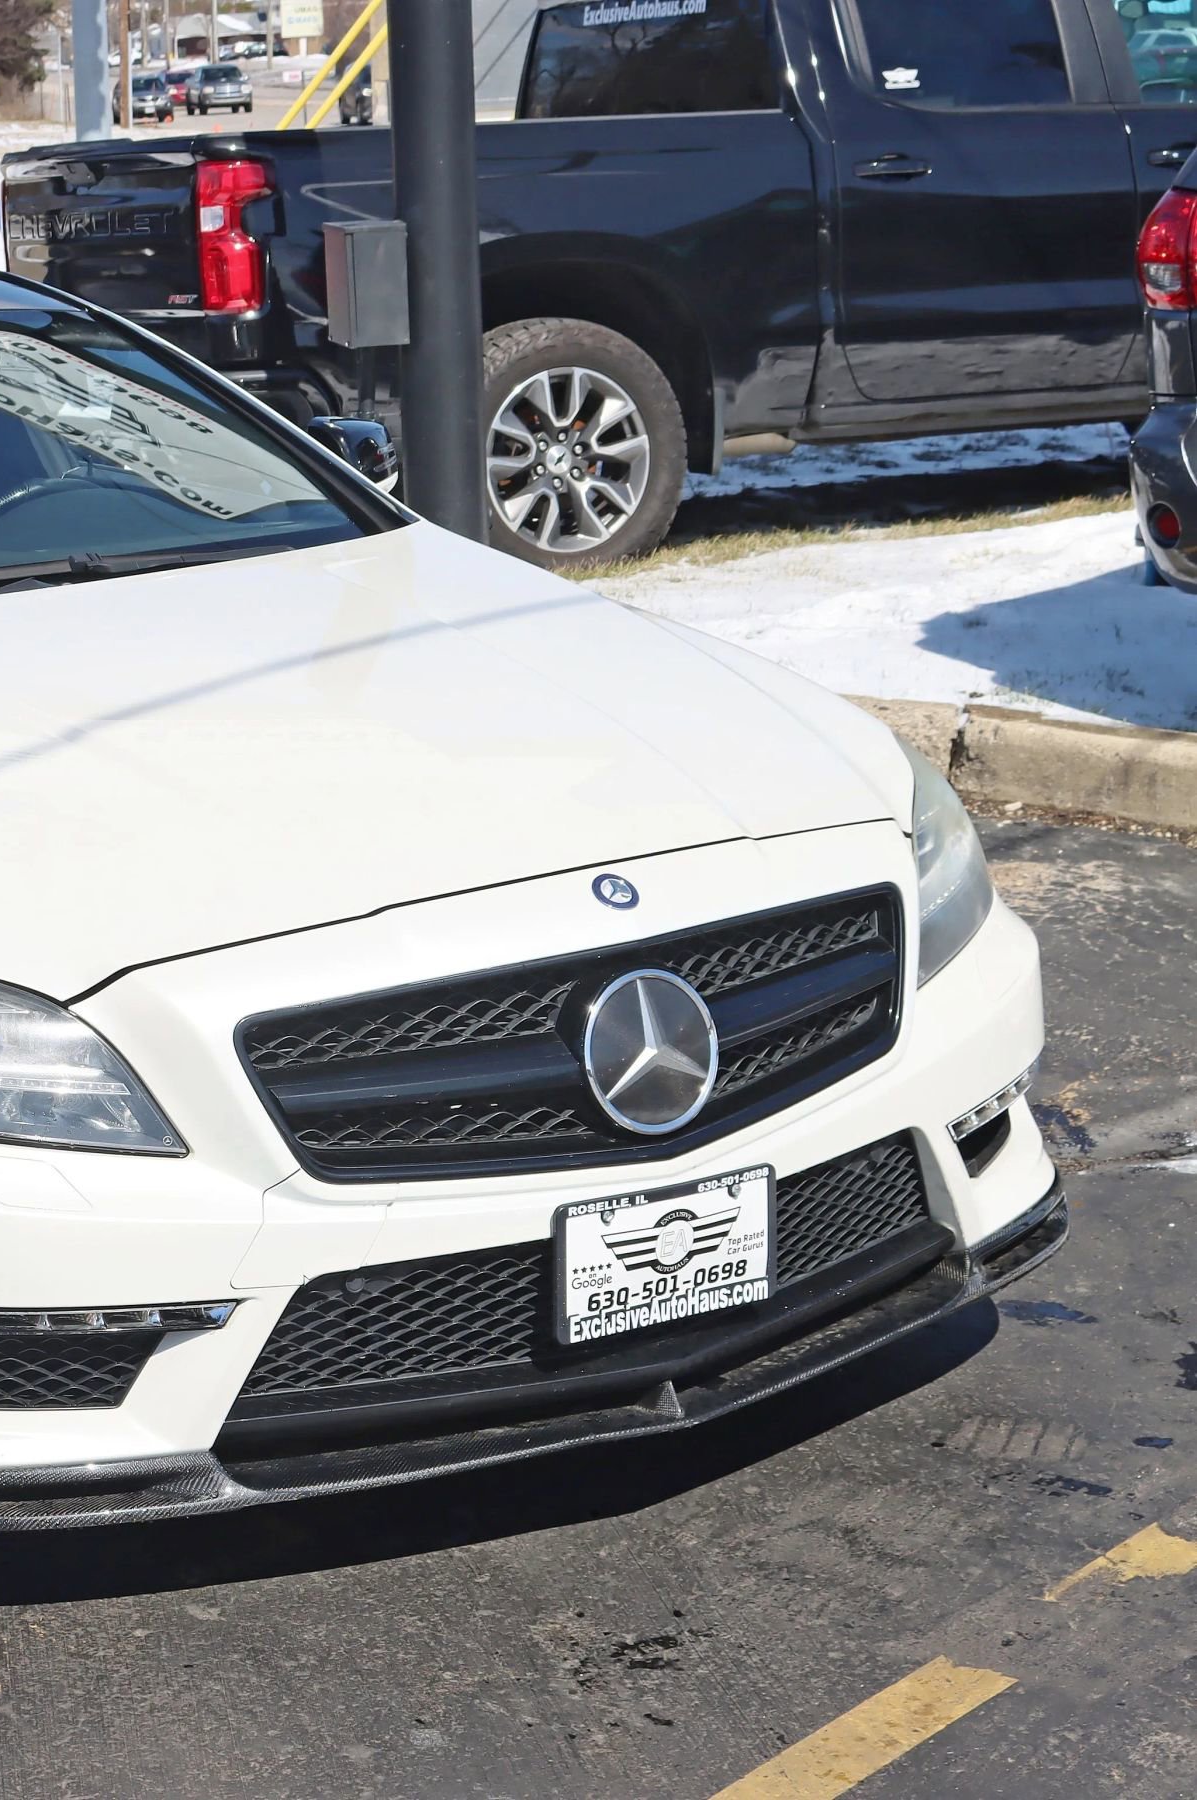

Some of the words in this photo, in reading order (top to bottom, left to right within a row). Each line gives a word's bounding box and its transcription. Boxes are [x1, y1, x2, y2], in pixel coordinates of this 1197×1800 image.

[583, 0, 707, 27] ExclusiveAutohaus.com
[9, 210, 175, 241] CHEVROLET
[697, 1167, 770, 1193] 630-501-0698
[568, 1197, 632, 1217] ROSELLE,
[635, 1195, 649, 1205] IL
[660, 1211, 693, 1226] EXCLUSIVE
[727, 1236, 742, 1247] Top
[743, 1229, 765, 1243] Rated
[727, 1246, 741, 1256] Car
[742, 1241, 765, 1253] Gurus
[655, 1256, 689, 1273] AUTOHAUS
[571, 1273, 613, 1290] Google
[587, 1259, 748, 1313] 630-501-0698
[569, 1279, 769, 1344] ExclusiveAutoHaus.com
